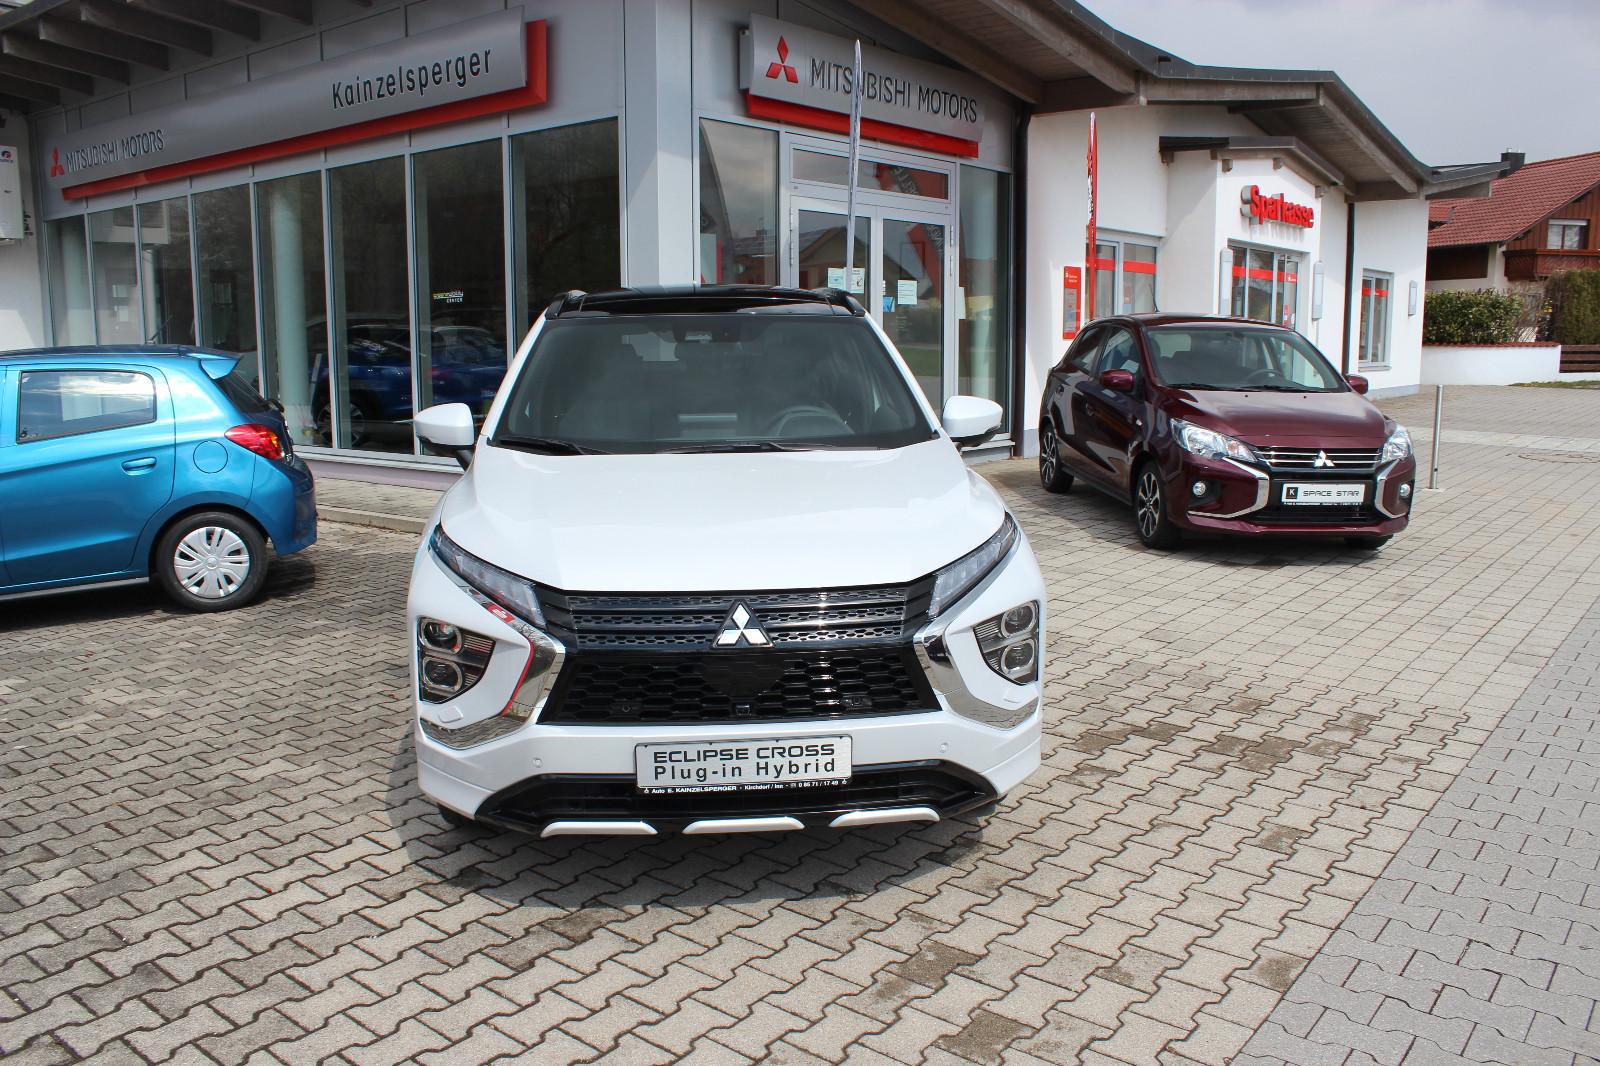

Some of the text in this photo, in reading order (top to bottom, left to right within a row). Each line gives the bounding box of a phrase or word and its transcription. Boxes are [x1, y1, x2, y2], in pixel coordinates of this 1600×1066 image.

[332, 49, 491, 109] Kainzelsperger
[918, 86, 977, 123] MOTORS
[66, 129, 164, 172] MITSUBISHI MOTORS
[1243, 185, 1314, 228] Sparkasse
[653, 743, 835, 764] ECLIPSE CROSS
[654, 758, 835, 782] Plug-in Hybrid
